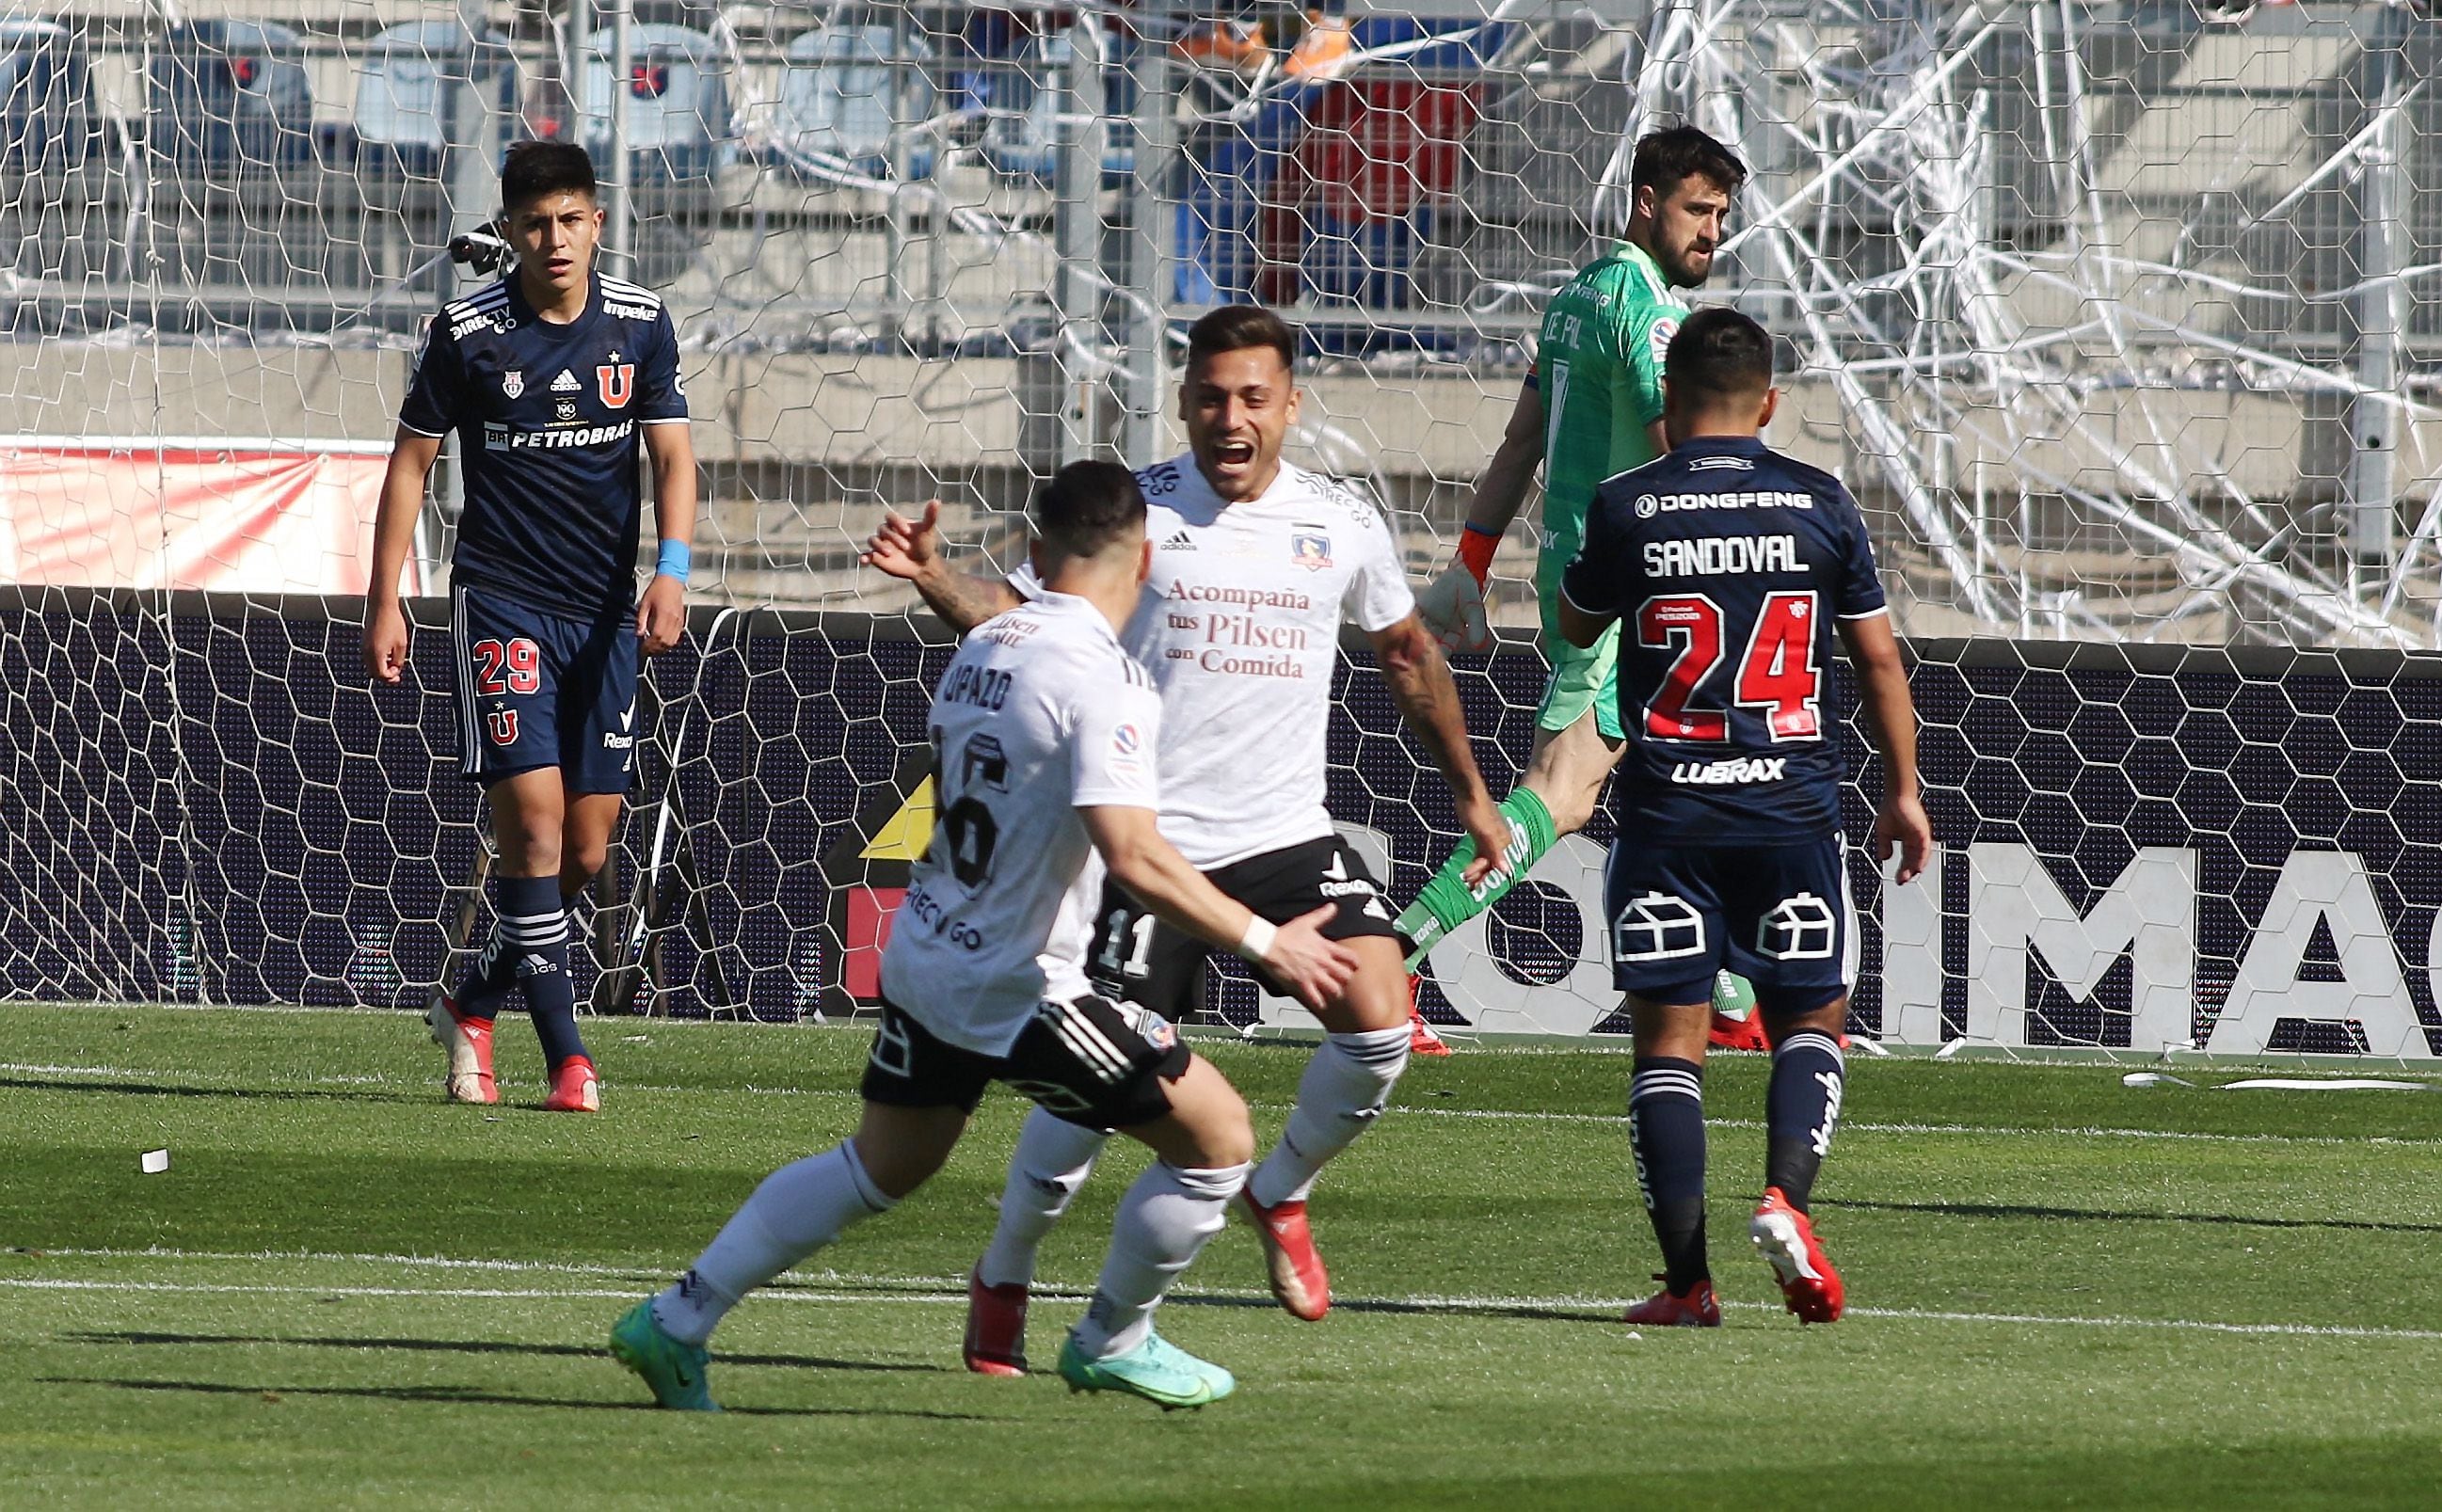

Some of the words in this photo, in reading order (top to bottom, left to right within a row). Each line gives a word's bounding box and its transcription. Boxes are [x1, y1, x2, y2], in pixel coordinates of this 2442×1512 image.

[493, 317, 518, 335] GO
[602, 299, 658, 322] Impeke
[550, 381, 583, 391] adidas
[597, 363, 636, 409] U
[487, 433, 508, 445] BR
[511, 419, 634, 449] PETROBRAS
[1659, 492, 1813, 512] DONGFENG
[1349, 509, 1371, 530] GO
[1159, 542, 1198, 551] adidas
[1643, 534, 1811, 578] SANDOVAL
[1167, 578, 1310, 613] Acompaña
[1167, 613, 1200, 630] tus
[1205, 612, 1307, 651] Pilsen
[472, 636, 542, 697] 29
[1164, 647, 1194, 661] con
[1199, 648, 1304, 679] Comida
[1635, 589, 1823, 744] 24
[487, 708, 520, 746] U
[1670, 756, 1787, 786] LUBRAX
[950, 921, 982, 951] GO
[1098, 908, 1157, 978] 11
